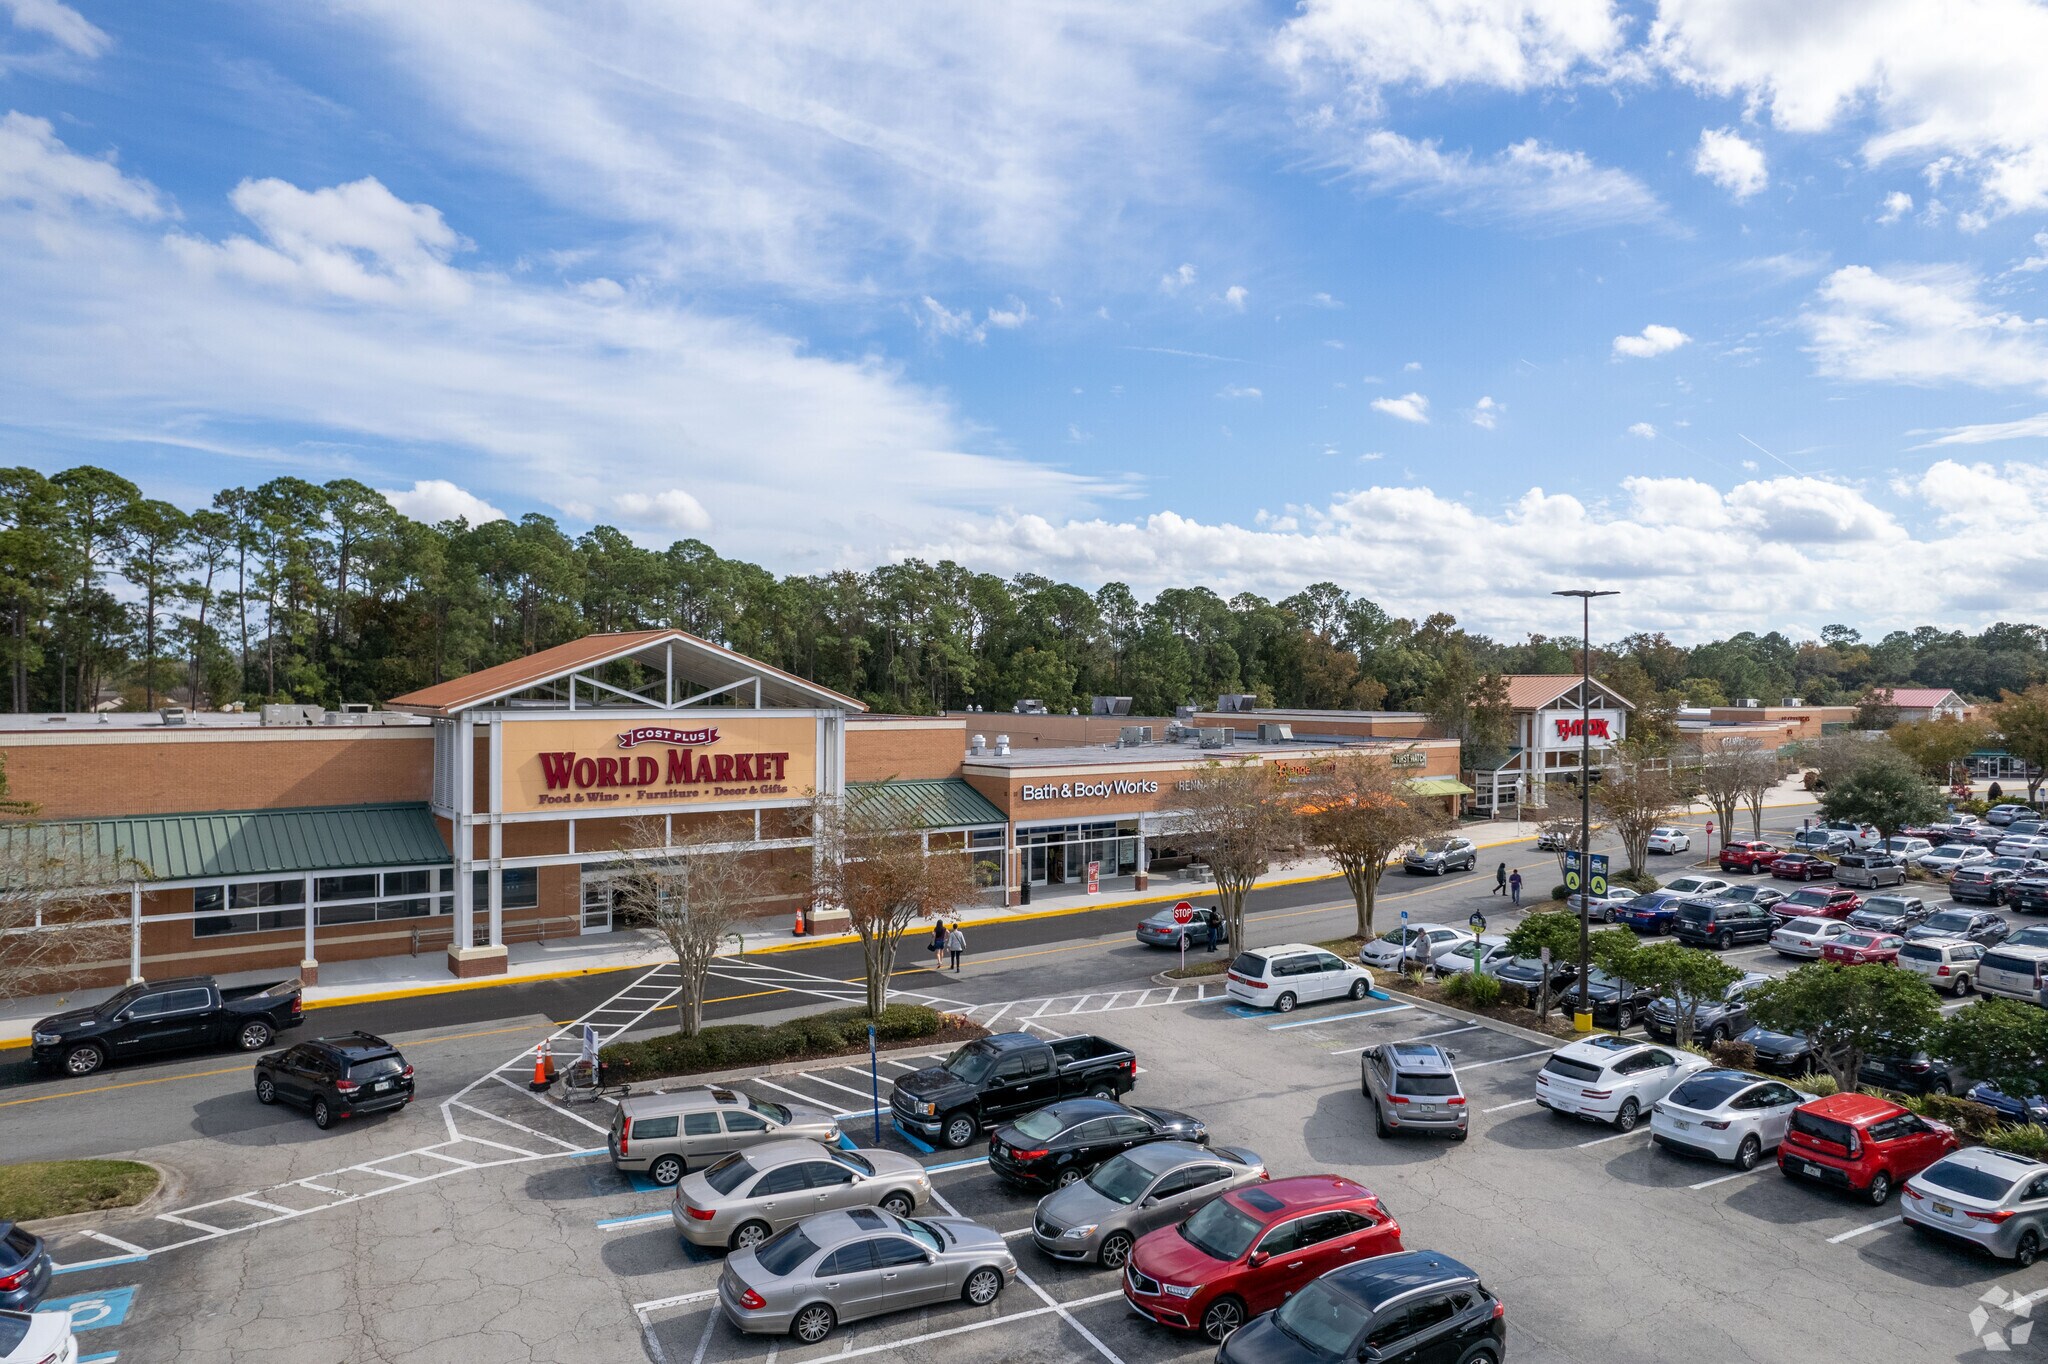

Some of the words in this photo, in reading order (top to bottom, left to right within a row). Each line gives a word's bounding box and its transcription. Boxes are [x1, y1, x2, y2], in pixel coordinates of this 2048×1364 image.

[636, 729, 671, 740] COST
[673, 731, 706, 742] PLUS
[538, 751, 660, 790] WORLD
[665, 748, 790, 786] MARKET
[539, 793, 571, 805] Food
[574, 792, 585, 803] &
[586, 791, 620, 802] Wine
[637, 788, 699, 800] Furniture
[713, 785, 748, 797] Decor
[748, 785, 759, 795] &
[759, 783, 788, 795] Gifts
[1022, 783, 1059, 801] Bath
[1060, 782, 1073, 799] &
[1074, 780, 1113, 799] Body
[1113, 778, 1159, 795] Works
[1568, 875, 1577, 887] A
[1594, 880, 1603, 891] A
[1174, 908, 1192, 919] STOP
